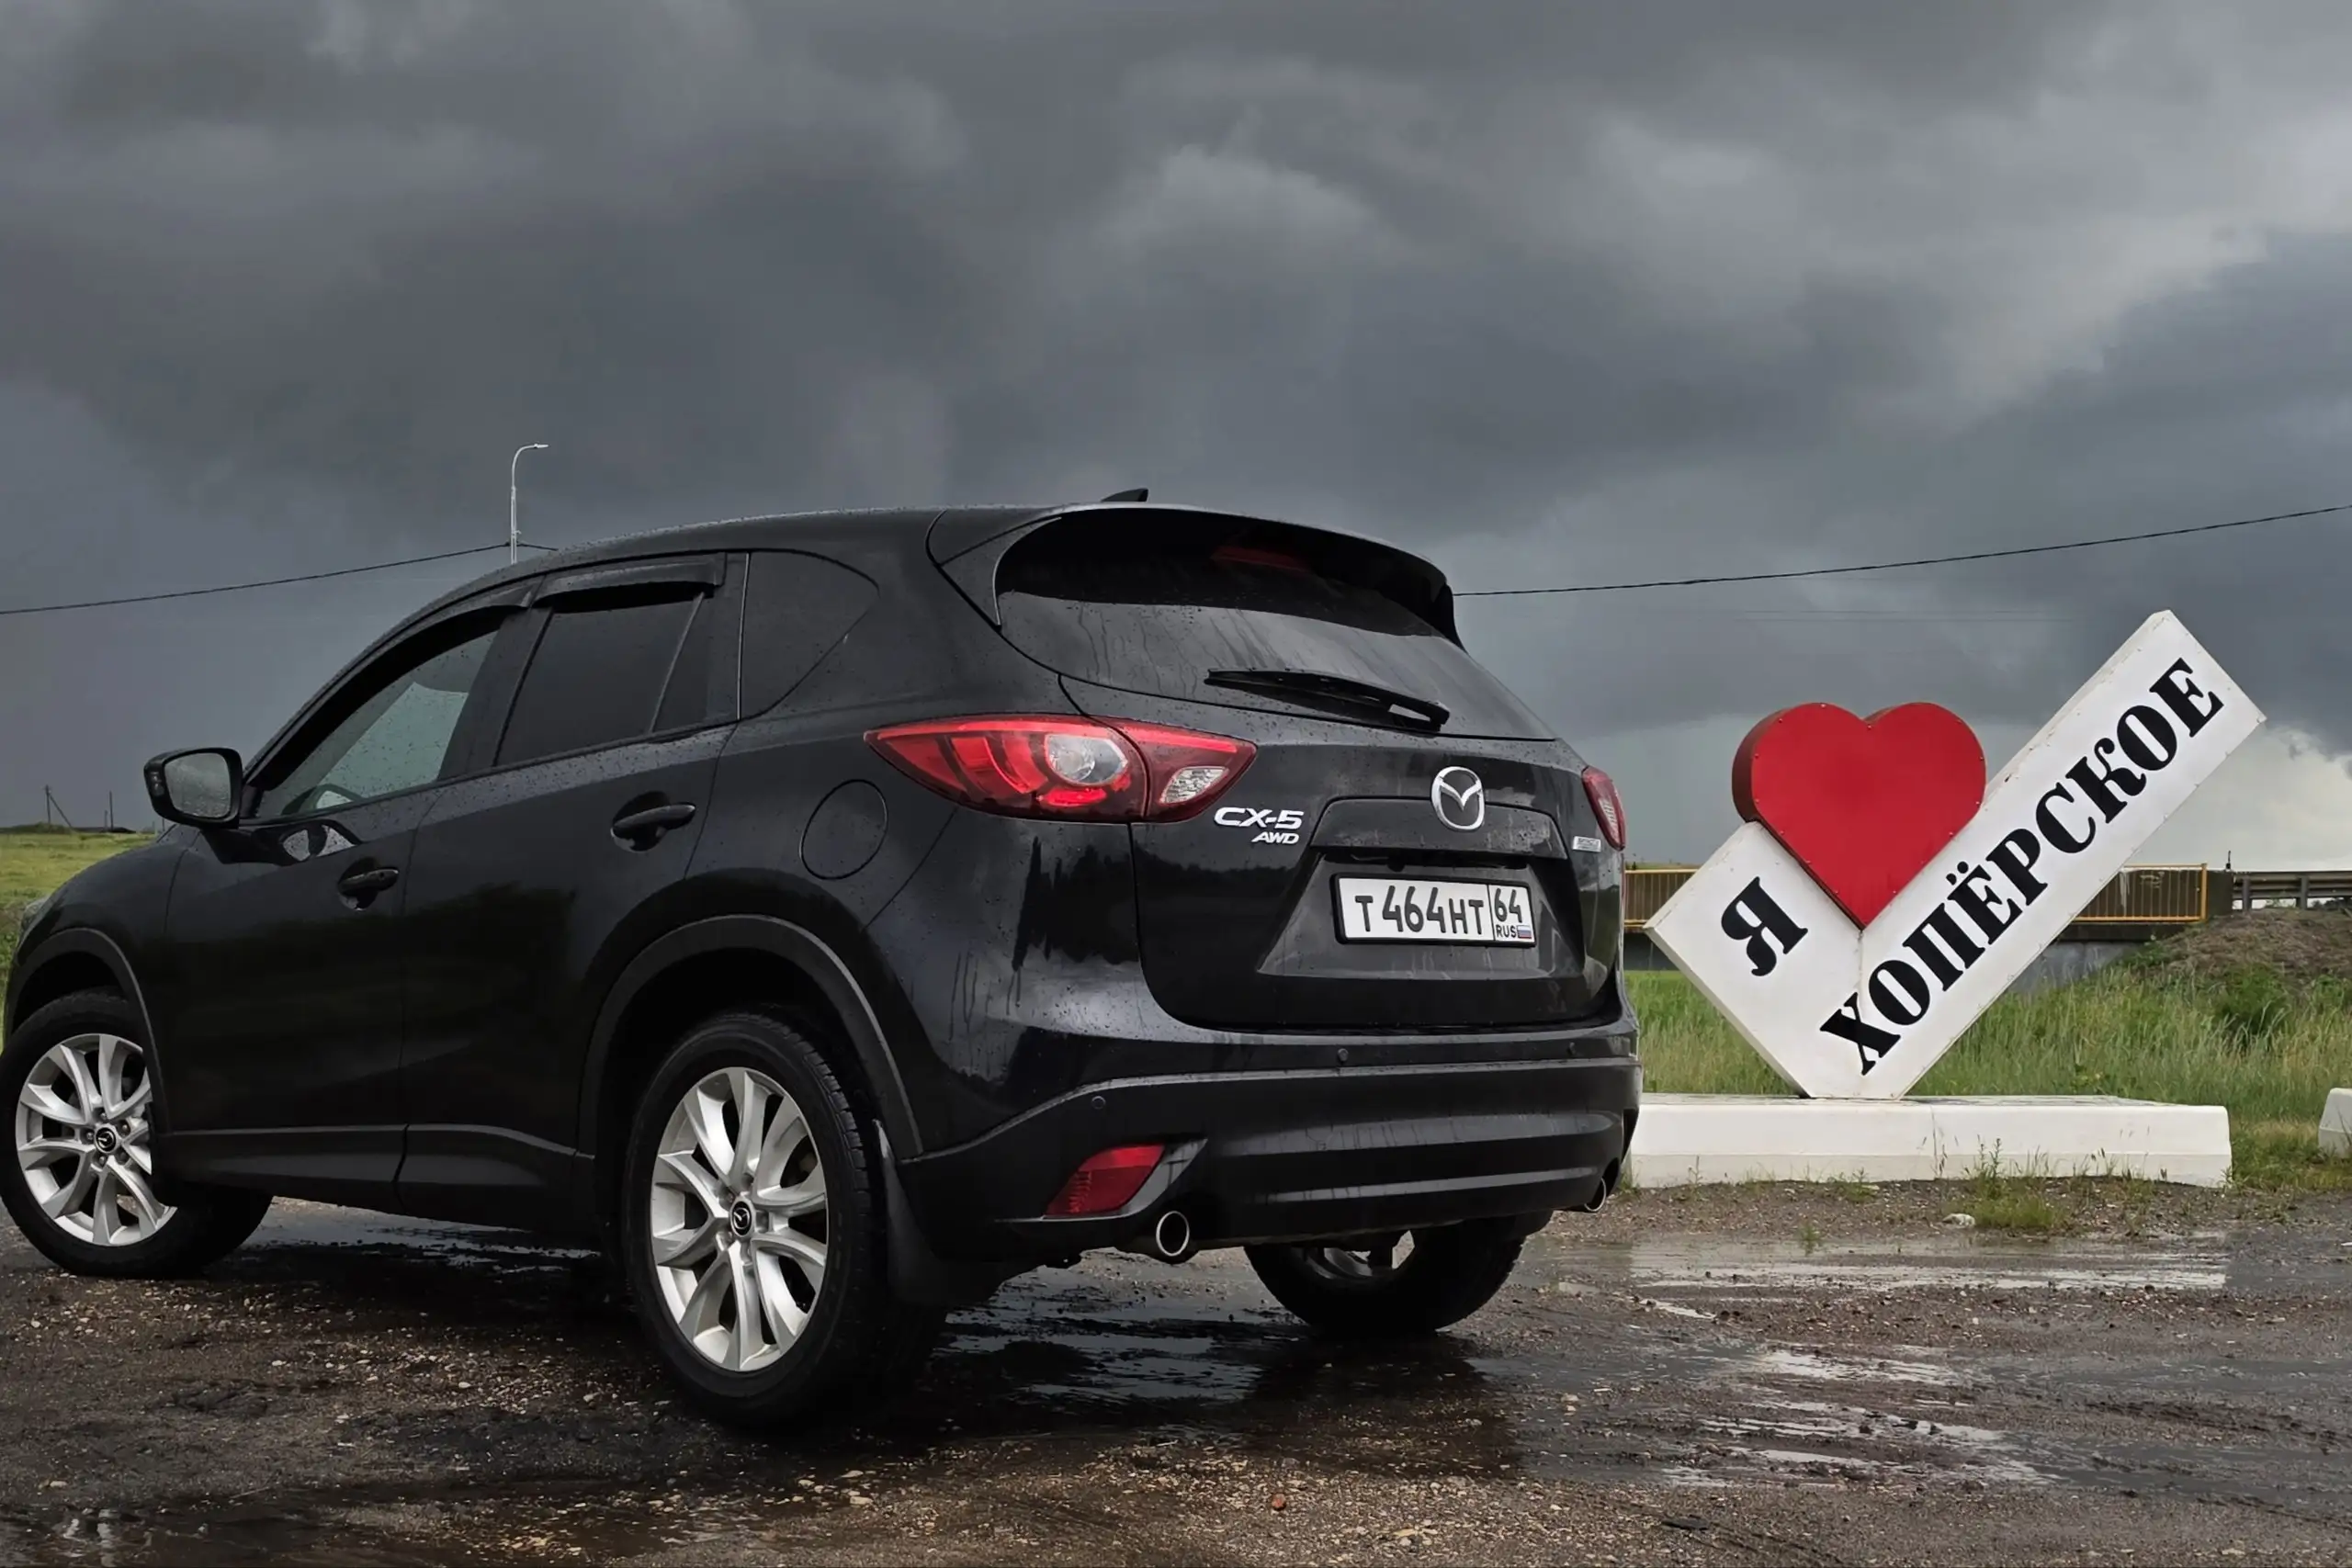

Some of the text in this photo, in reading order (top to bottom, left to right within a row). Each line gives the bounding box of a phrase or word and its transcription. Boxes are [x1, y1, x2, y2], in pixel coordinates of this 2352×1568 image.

[1214, 807, 1305, 829] CX-5
[1250, 830, 1300, 844] AWD
[1819, 658, 2224, 1076] ХОПЁРСКОЕ
[1494, 887, 1522, 923] 64
[1495, 924, 1517, 939] RUS
[1721, 876, 1808, 976] Я
